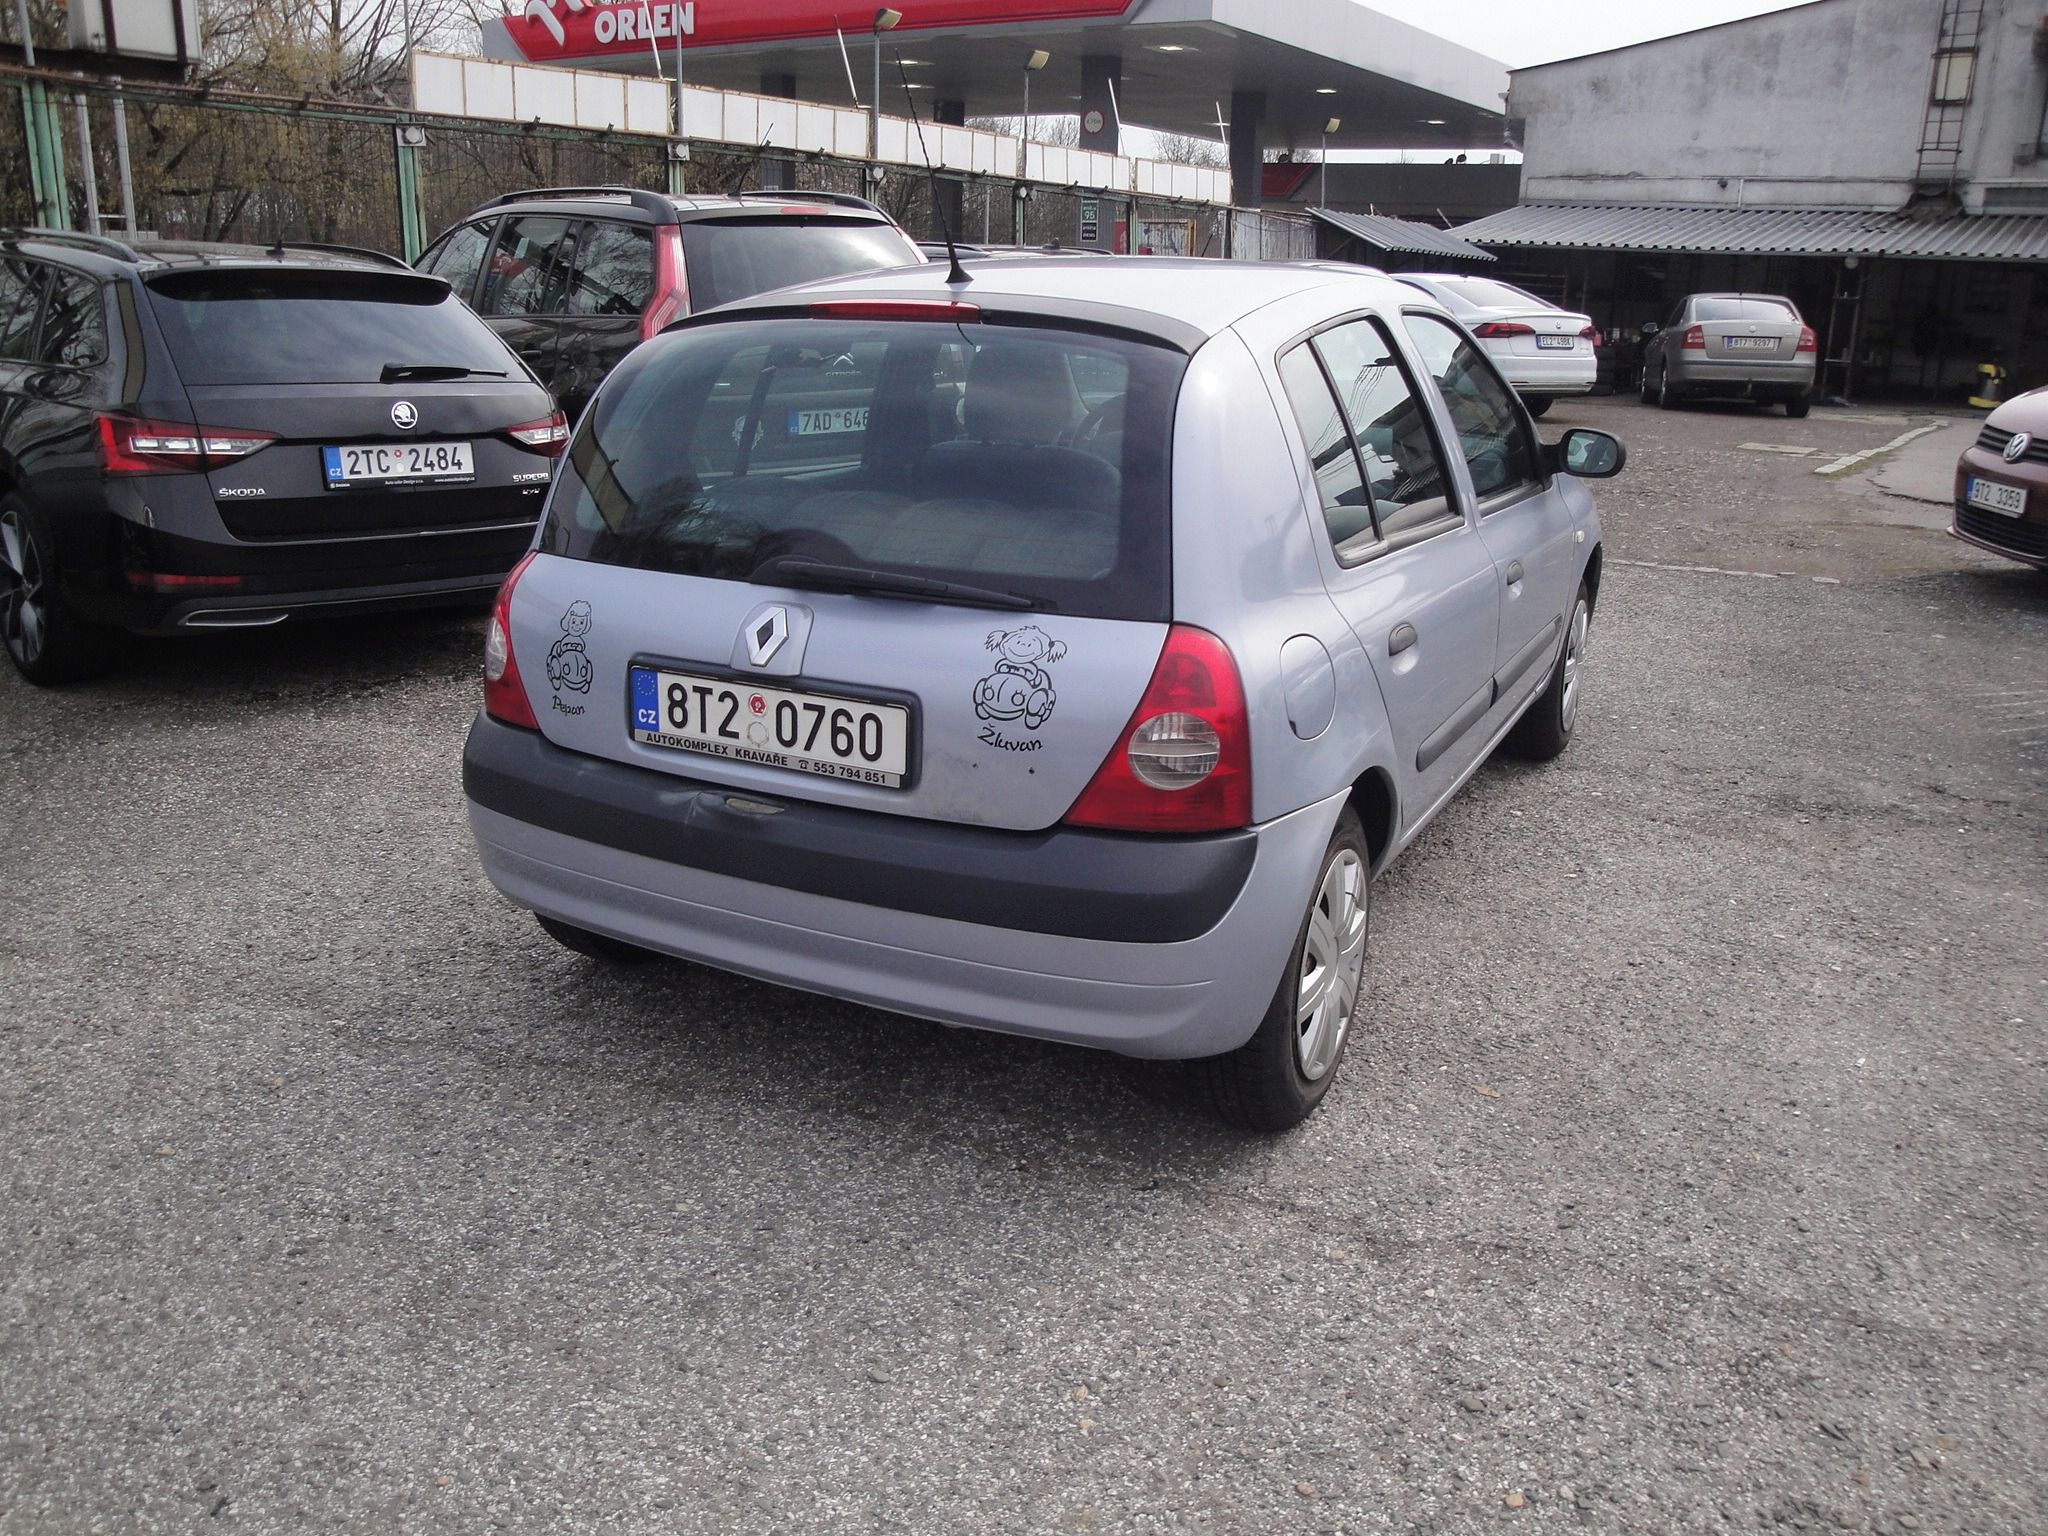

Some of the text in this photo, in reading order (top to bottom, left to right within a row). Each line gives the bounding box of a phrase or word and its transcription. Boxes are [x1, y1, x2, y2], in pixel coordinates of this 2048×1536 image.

[595, 2, 695, 44] ORLEN
[1084, 211, 1095, 219] 95
[803, 412, 832, 432] 7AD
[347, 446, 463, 476] 2TC 2484
[329, 468, 342, 476] CZ
[512, 472, 549, 483] SUPERB
[219, 487, 267, 498] ŠKODA
[638, 709, 657, 724] CZ
[667, 682, 883, 762] 8T2 0760
[646, 732, 886, 784] AUTOKOMPLEX KRAVAŘE 553 794 851
